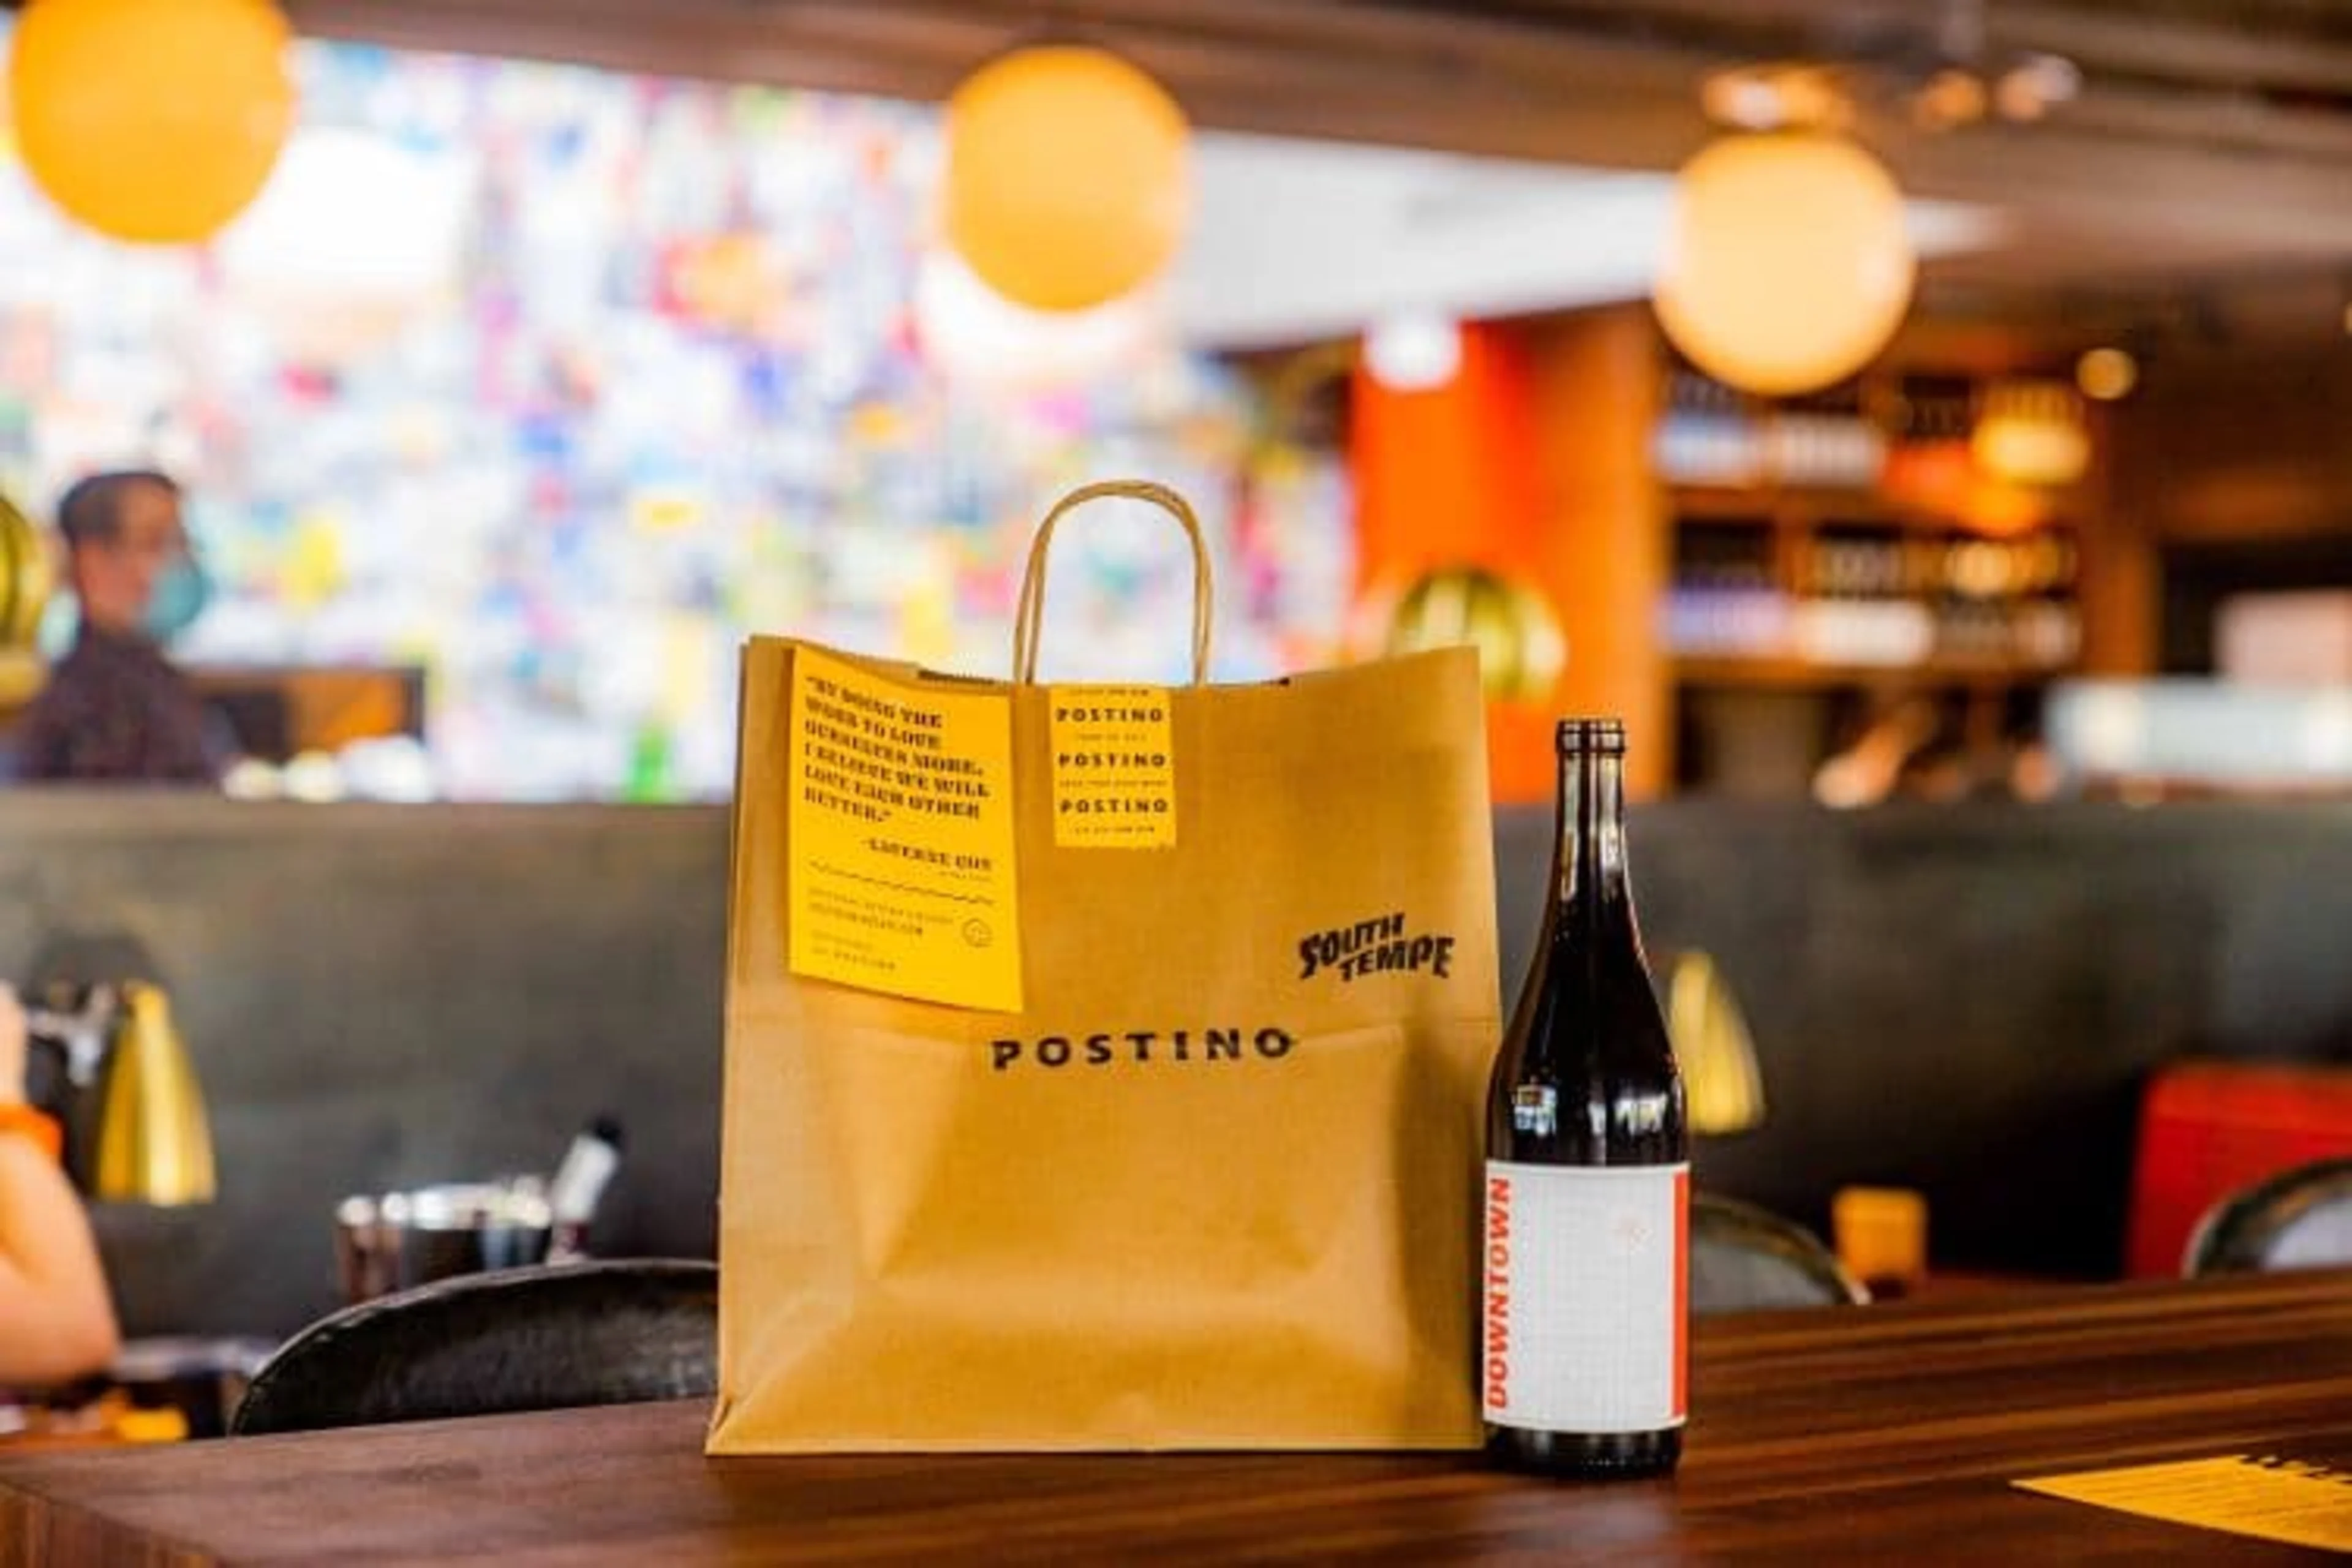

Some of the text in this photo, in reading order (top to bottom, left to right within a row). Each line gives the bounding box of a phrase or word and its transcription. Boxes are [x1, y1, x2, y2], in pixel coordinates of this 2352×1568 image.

[864, 718, 886, 738] TO
[890, 727, 941, 750] LOVE
[900, 706, 942, 729] THE
[1057, 707, 1162, 723] POSTINO
[805, 742, 990, 797] I BELIEVE WE WILL
[1059, 752, 1165, 768] POSTINO
[805, 764, 849, 789] LOVE
[909, 796, 979, 819] OTHER
[1060, 798, 1167, 814] POSTINO
[1299, 912, 1405, 980] SOUTH
[1338, 932, 1455, 982] TEMPE
[992, 1027, 1295, 1071] POSTINO
[1486, 1177, 1510, 1409] DOWNTOWN
